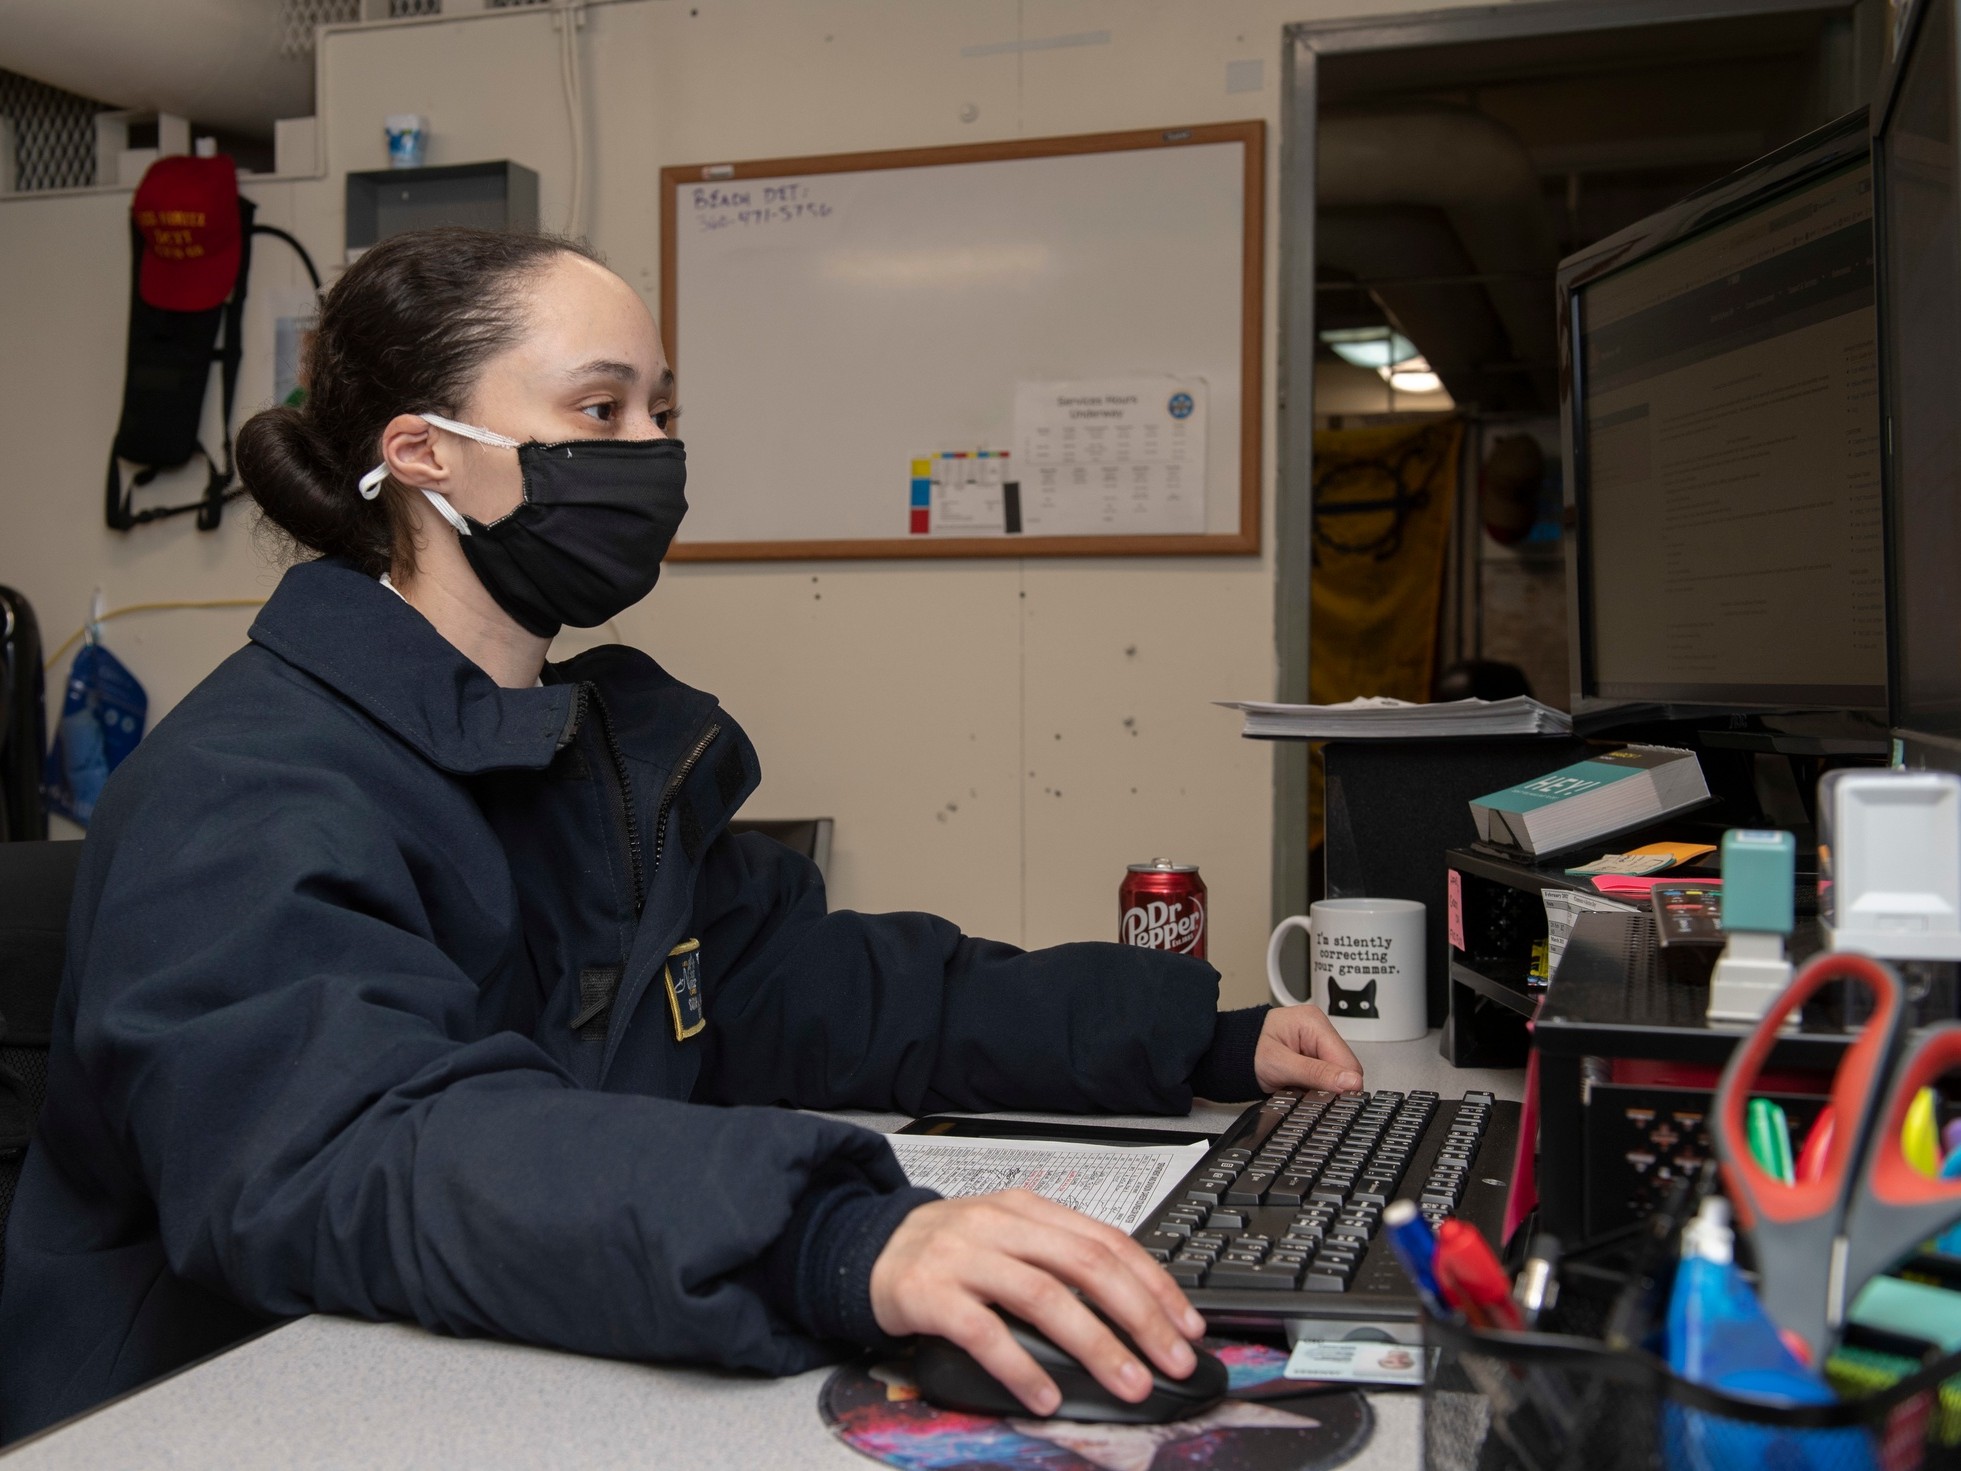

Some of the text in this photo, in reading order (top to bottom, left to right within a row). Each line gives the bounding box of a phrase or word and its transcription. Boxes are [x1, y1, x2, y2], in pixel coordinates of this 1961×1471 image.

[693, 187, 751, 209] BEACH
[1057, 394, 1138, 406] Services Hours
[1069, 408, 1124, 420] Underway
[1524, 775, 1600, 796] HEY!
[1147, 901, 1182, 930] Dr
[1122, 907, 1200, 950] Pepper
[1317, 932, 1393, 950] I'm silently
[1320, 949, 1388, 964] correcting
[1314, 960, 1400, 976] your grammar.
